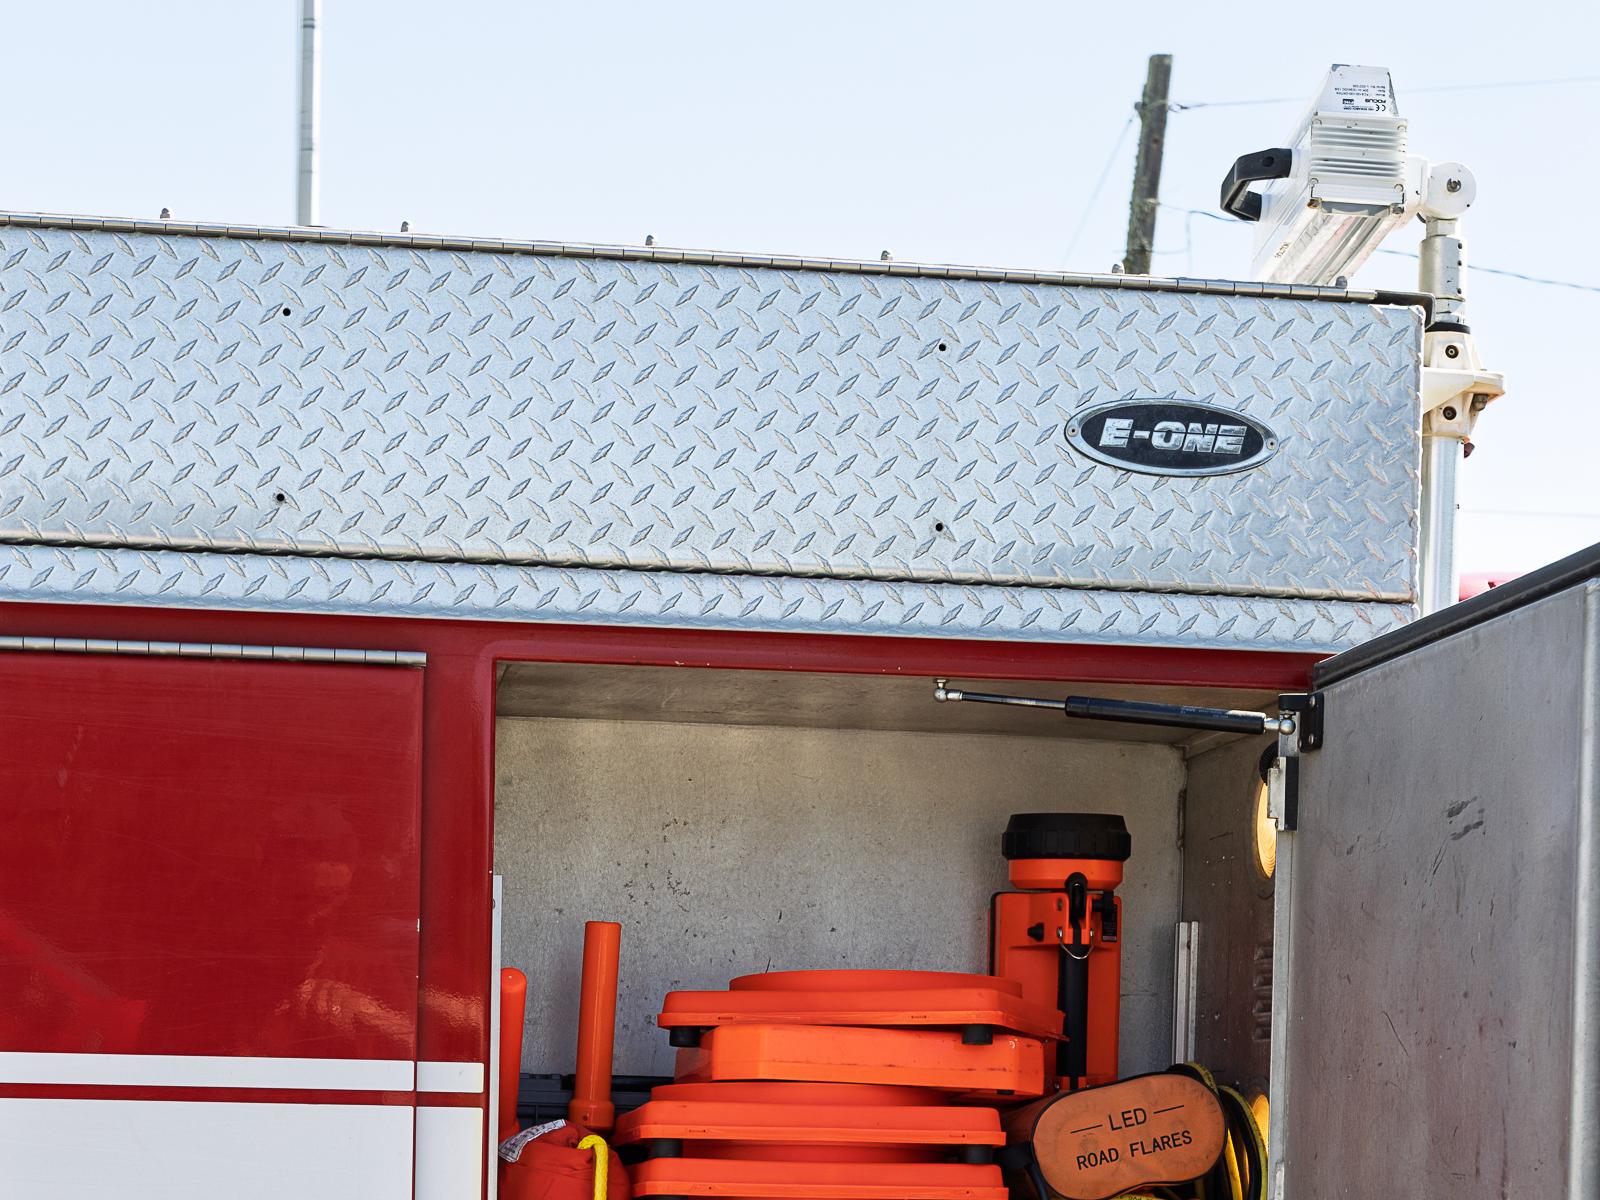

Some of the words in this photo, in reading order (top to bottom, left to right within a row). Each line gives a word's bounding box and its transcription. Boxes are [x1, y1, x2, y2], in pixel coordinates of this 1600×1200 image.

[1099, 418, 1247, 454] E-ONE
[1108, 1107, 1147, 1131] LED
[1076, 1147, 1119, 1170] ROAD
[1129, 1129, 1193, 1157] FLARES
